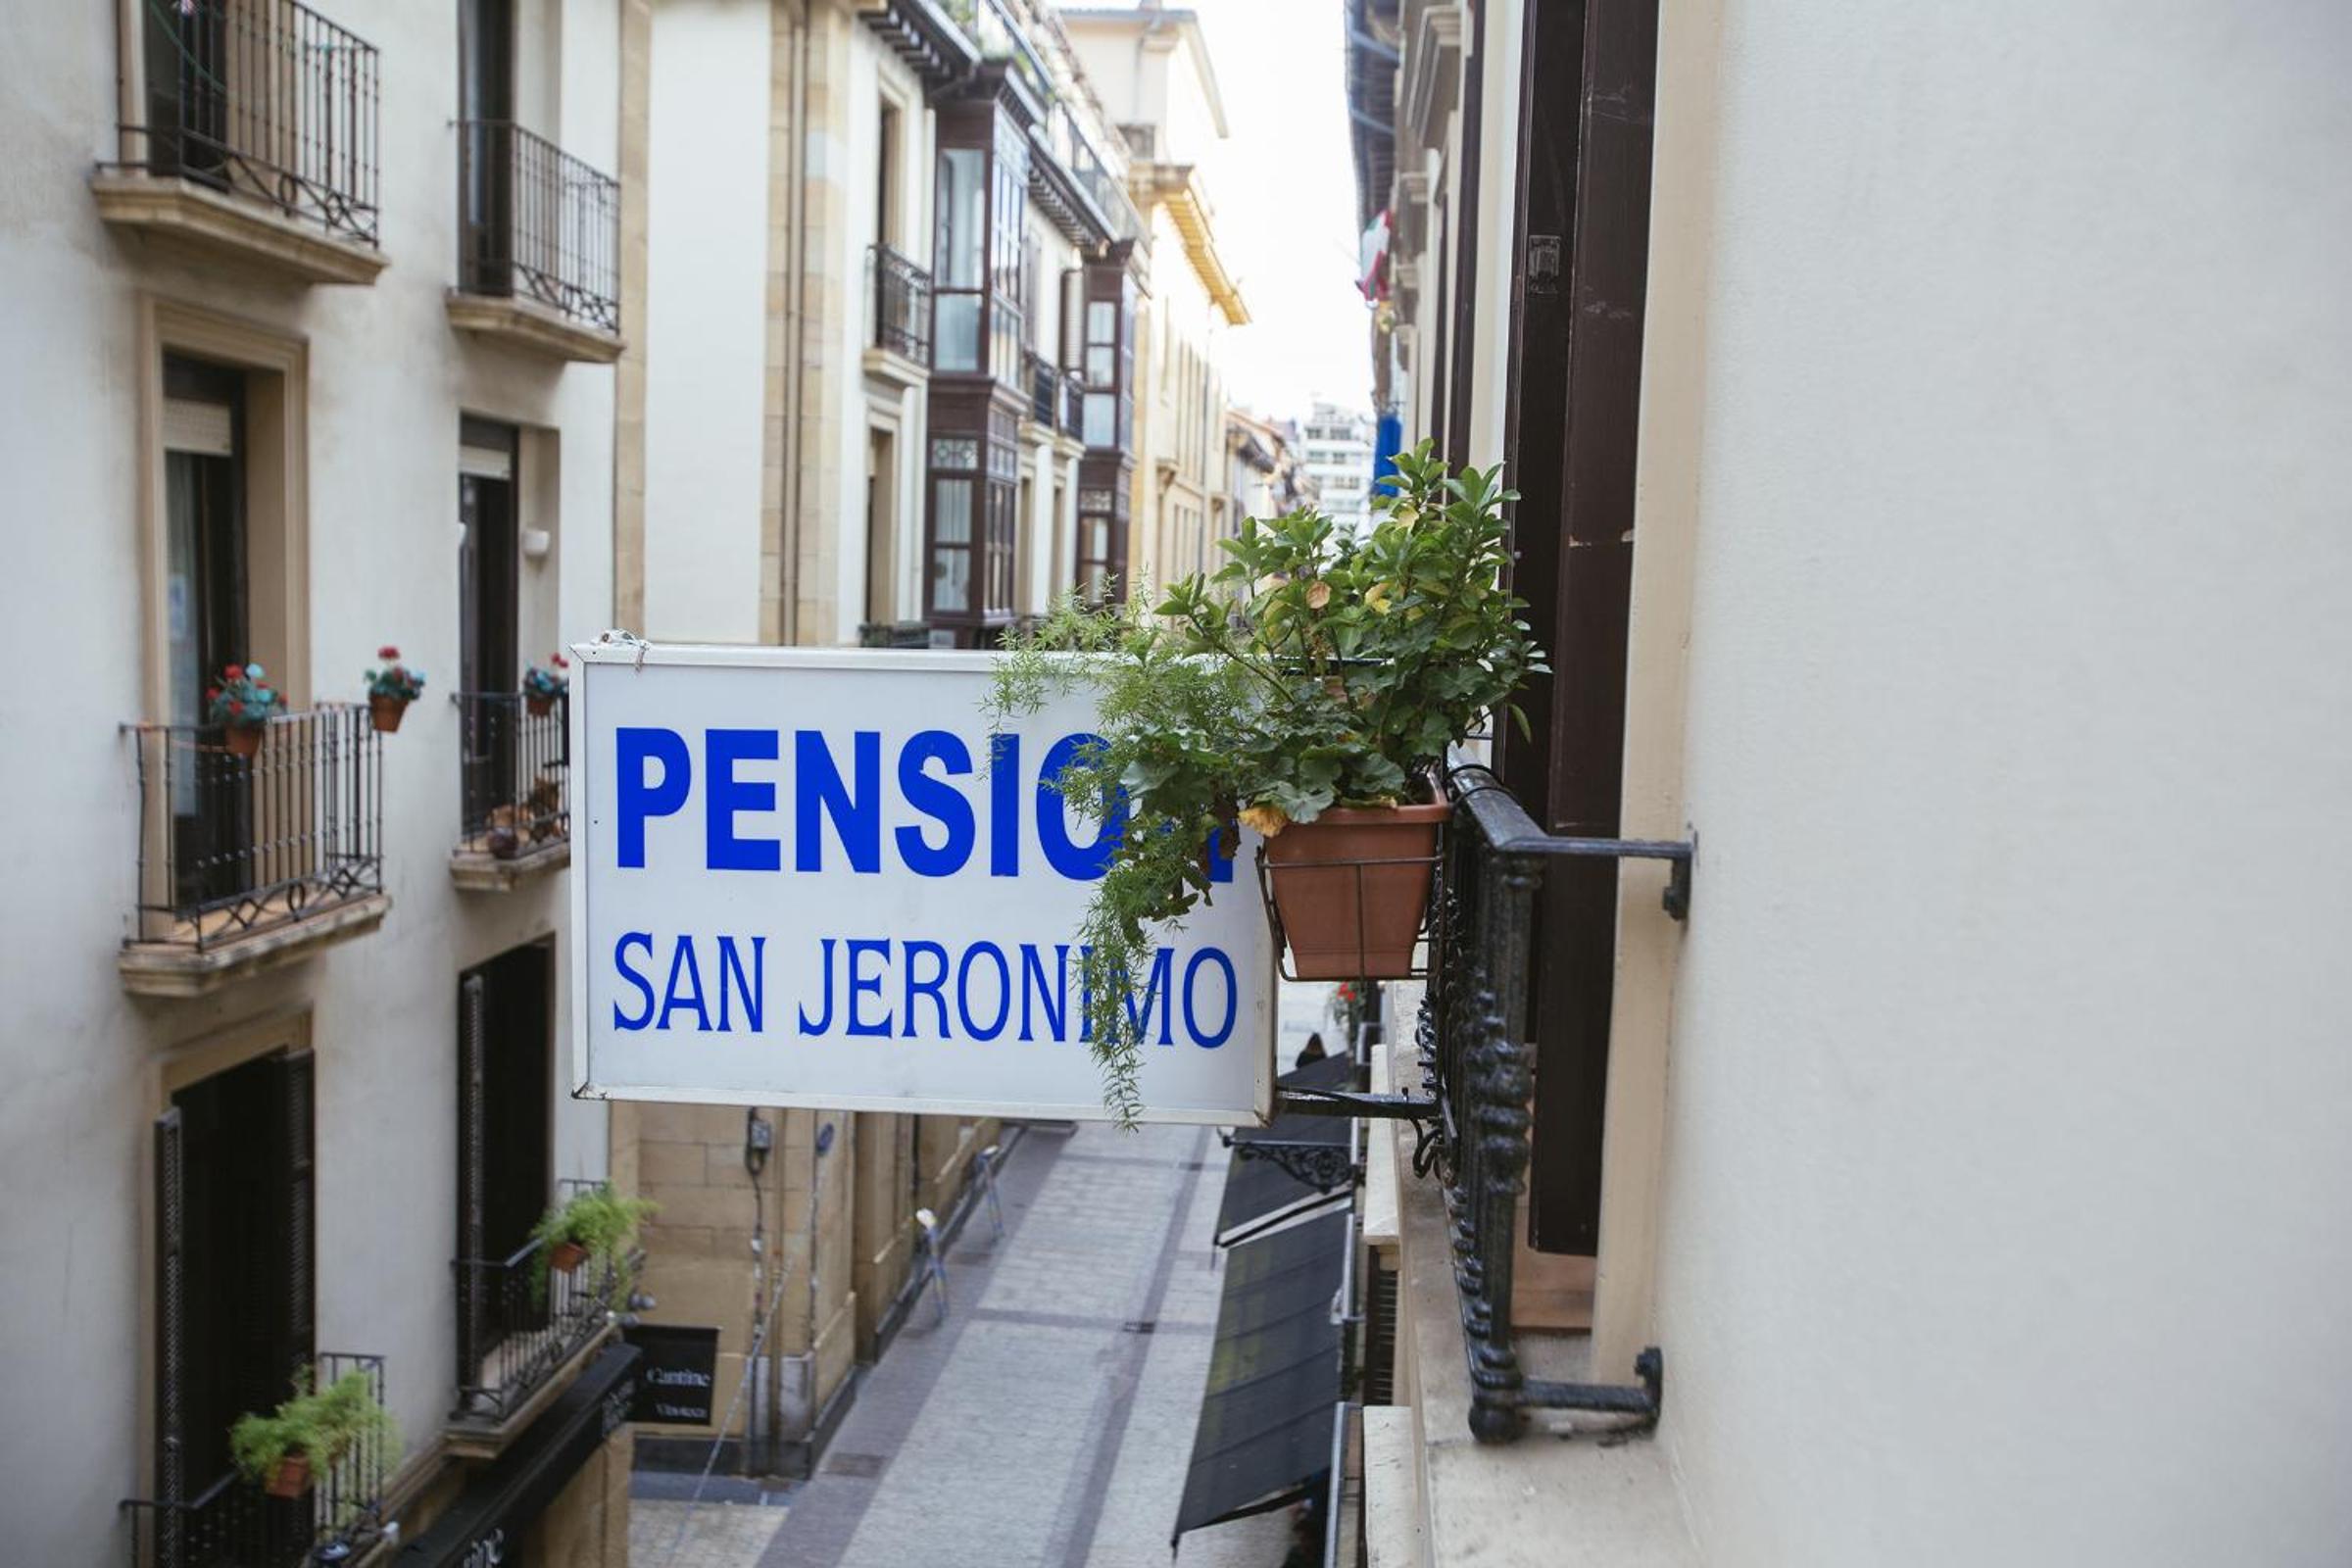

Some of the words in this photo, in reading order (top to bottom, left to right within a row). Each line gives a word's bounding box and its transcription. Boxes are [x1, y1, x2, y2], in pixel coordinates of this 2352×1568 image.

[615, 726, 1233, 882] PENSIO
[613, 931, 765, 1033] SAN
[799, 938, 1237, 1049] JERONIMO
